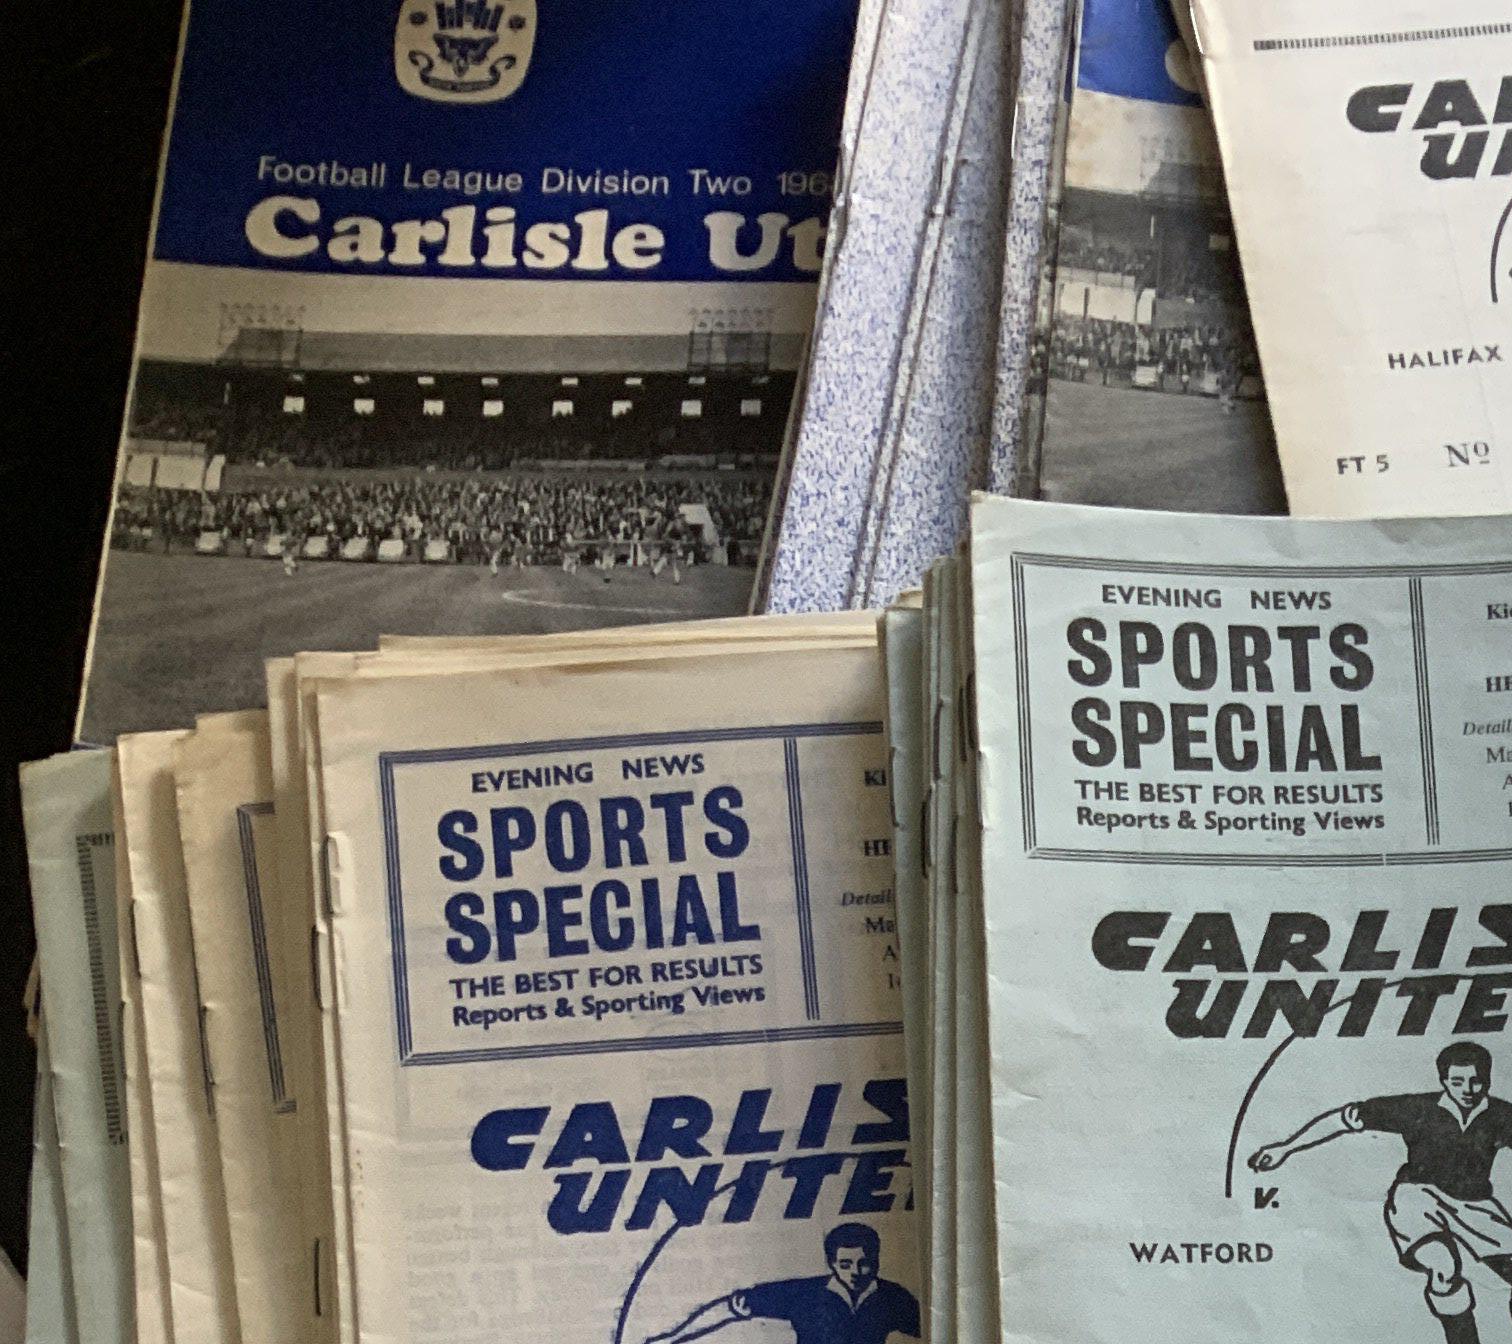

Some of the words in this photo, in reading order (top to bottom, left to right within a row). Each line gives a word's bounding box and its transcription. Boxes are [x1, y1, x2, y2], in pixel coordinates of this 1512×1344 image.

[258, 156, 386, 187] Football
[404, 164, 522, 195] League
[542, 169, 669, 194] Division
[689, 169, 751, 195] Two
[246, 197, 664, 270] Carlisle
[1388, 346, 1501, 369] HALIFAX
[1102, 585, 1221, 608] EVENING
[1251, 591, 1331, 610] NEWS
[1067, 617, 1374, 692] SPORTS
[1071, 697, 1382, 772] SPECIAL
[1074, 780, 1129, 801] THE
[1139, 783, 1202, 804] BEST
[1213, 785, 1265, 805] FOR
[1274, 784, 1383, 804] RESULTS
[438, 786, 749, 882] SPORTS
[445, 872, 760, 964] SPECIAL
[1130, 1243, 1273, 1264] WATFORD
